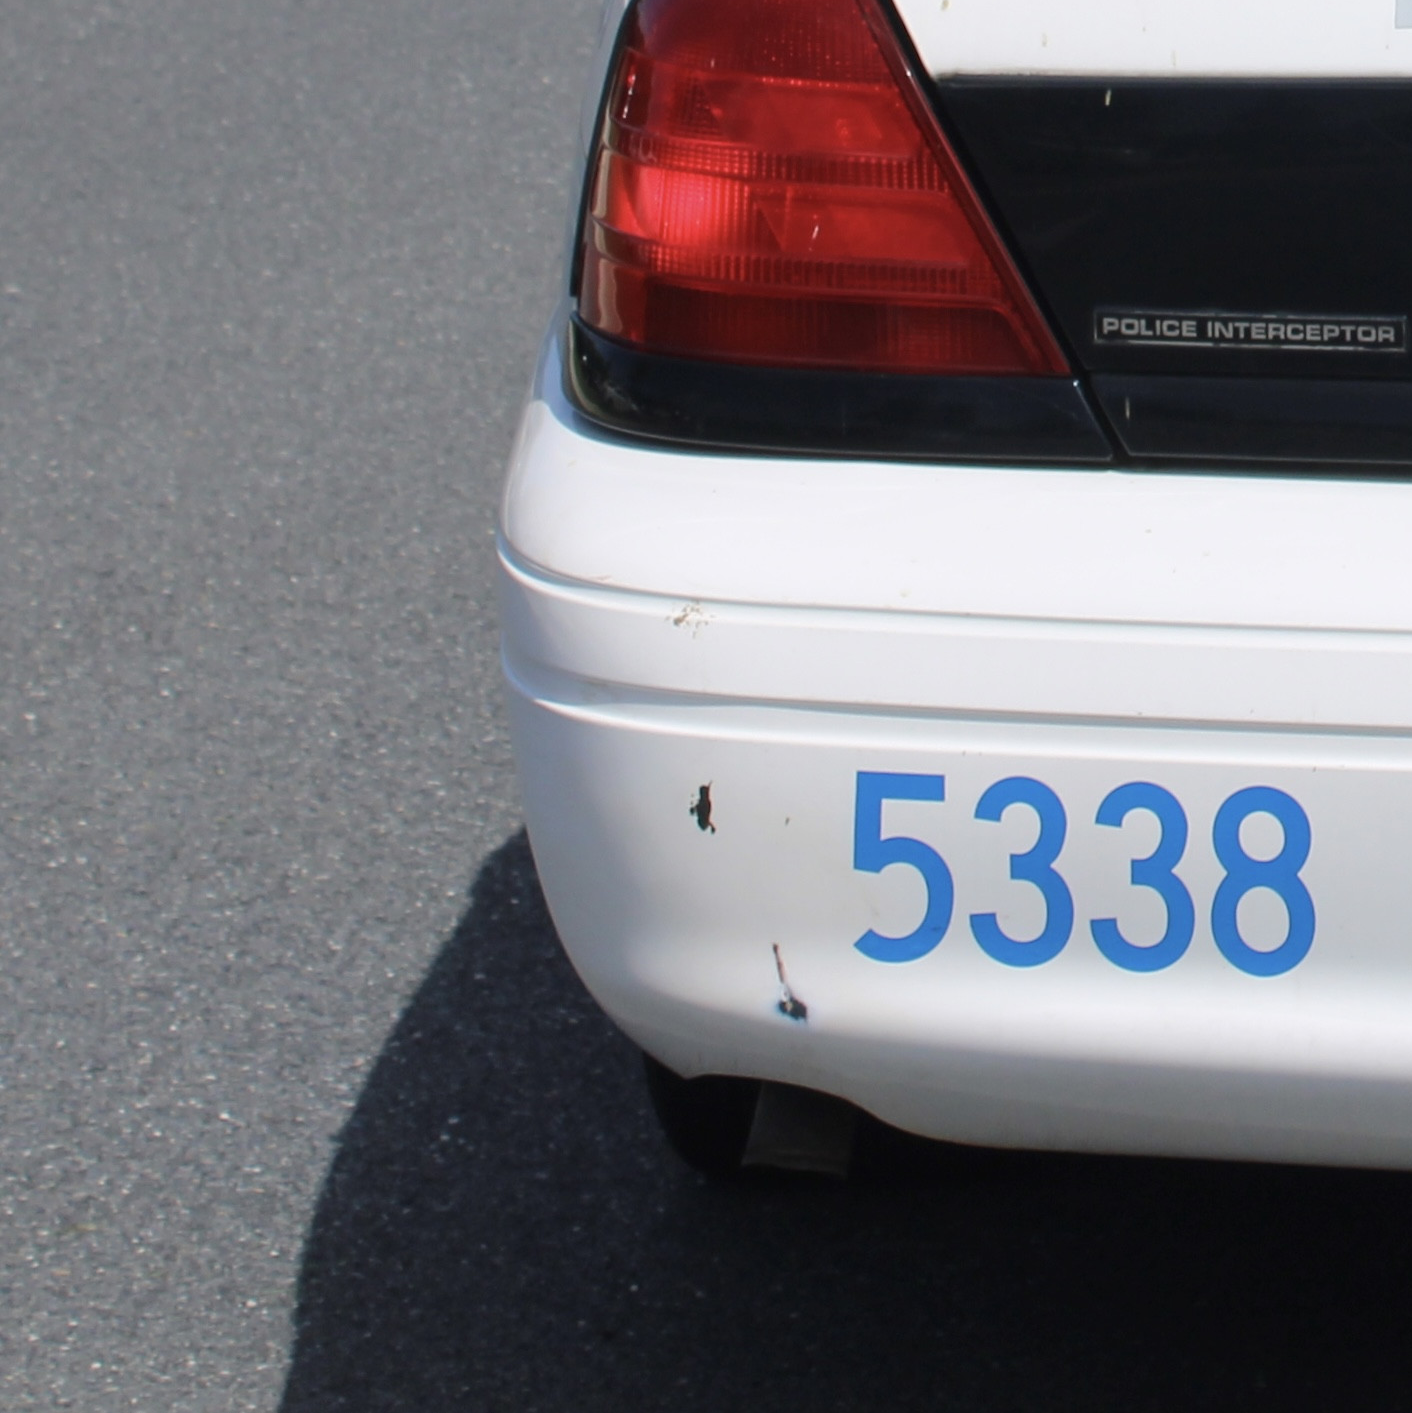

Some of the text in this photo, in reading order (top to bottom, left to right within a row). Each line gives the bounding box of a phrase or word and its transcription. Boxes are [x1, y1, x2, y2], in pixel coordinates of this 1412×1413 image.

[1102, 317, 1395, 342] POLICE INTERCEPTOR
[853, 771, 1316, 977] 5338
